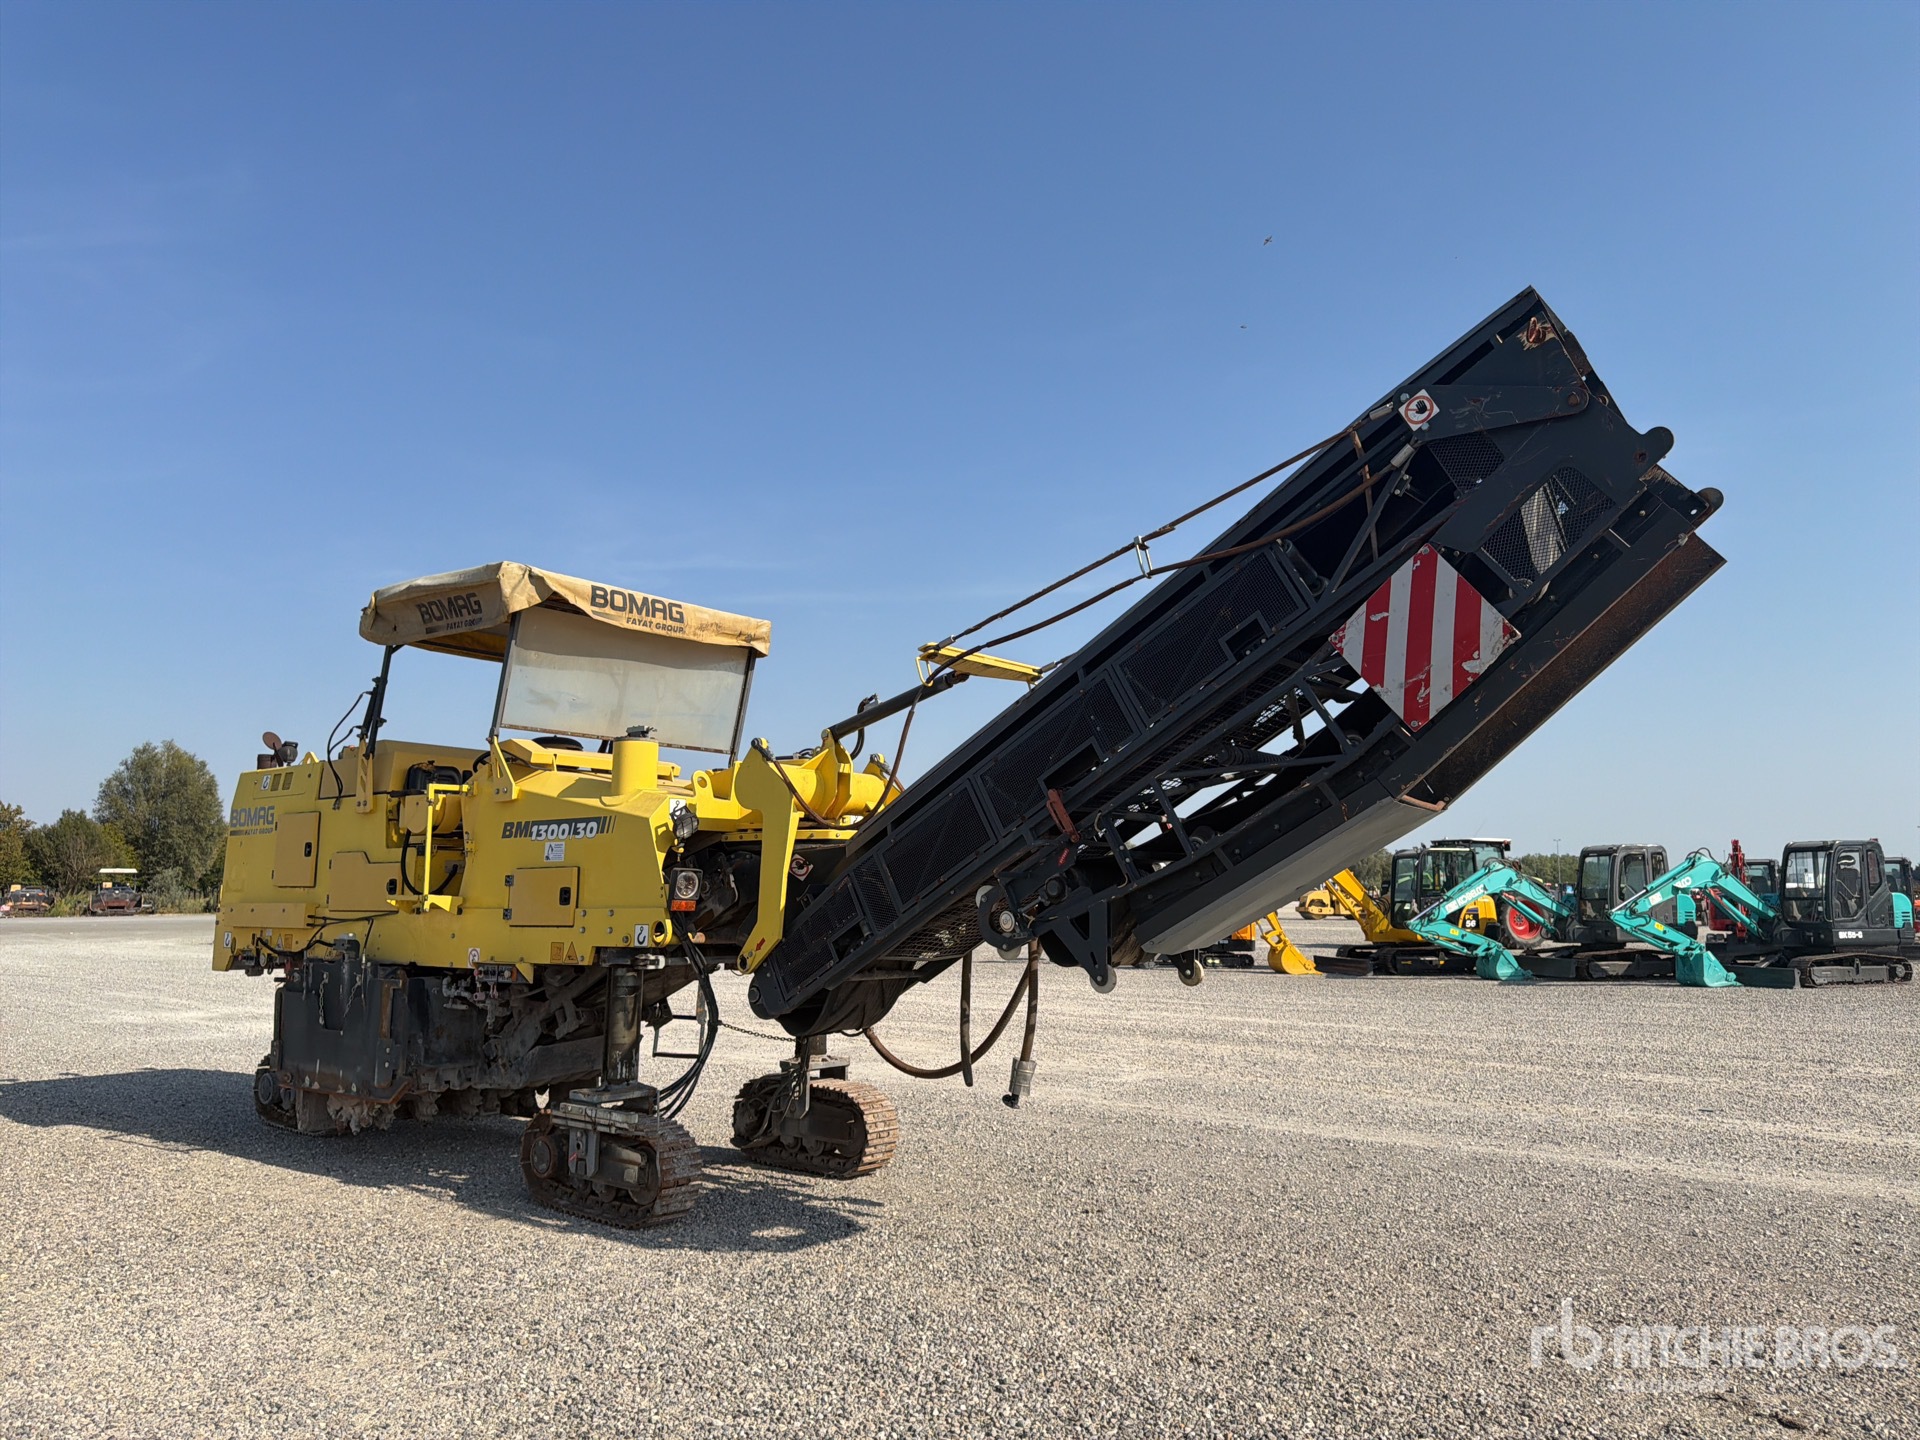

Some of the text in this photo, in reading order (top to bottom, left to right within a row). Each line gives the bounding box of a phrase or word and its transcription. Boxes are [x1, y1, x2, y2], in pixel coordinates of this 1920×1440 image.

[415, 592, 483, 624] BOMAG
[590, 585, 685, 624] BOMAG
[446, 620, 464, 630] FAYAT
[626, 617, 685, 634] FAYAT GROUP
[230, 805, 275, 828] BOMAG
[1465, 920, 1477, 928] 56
